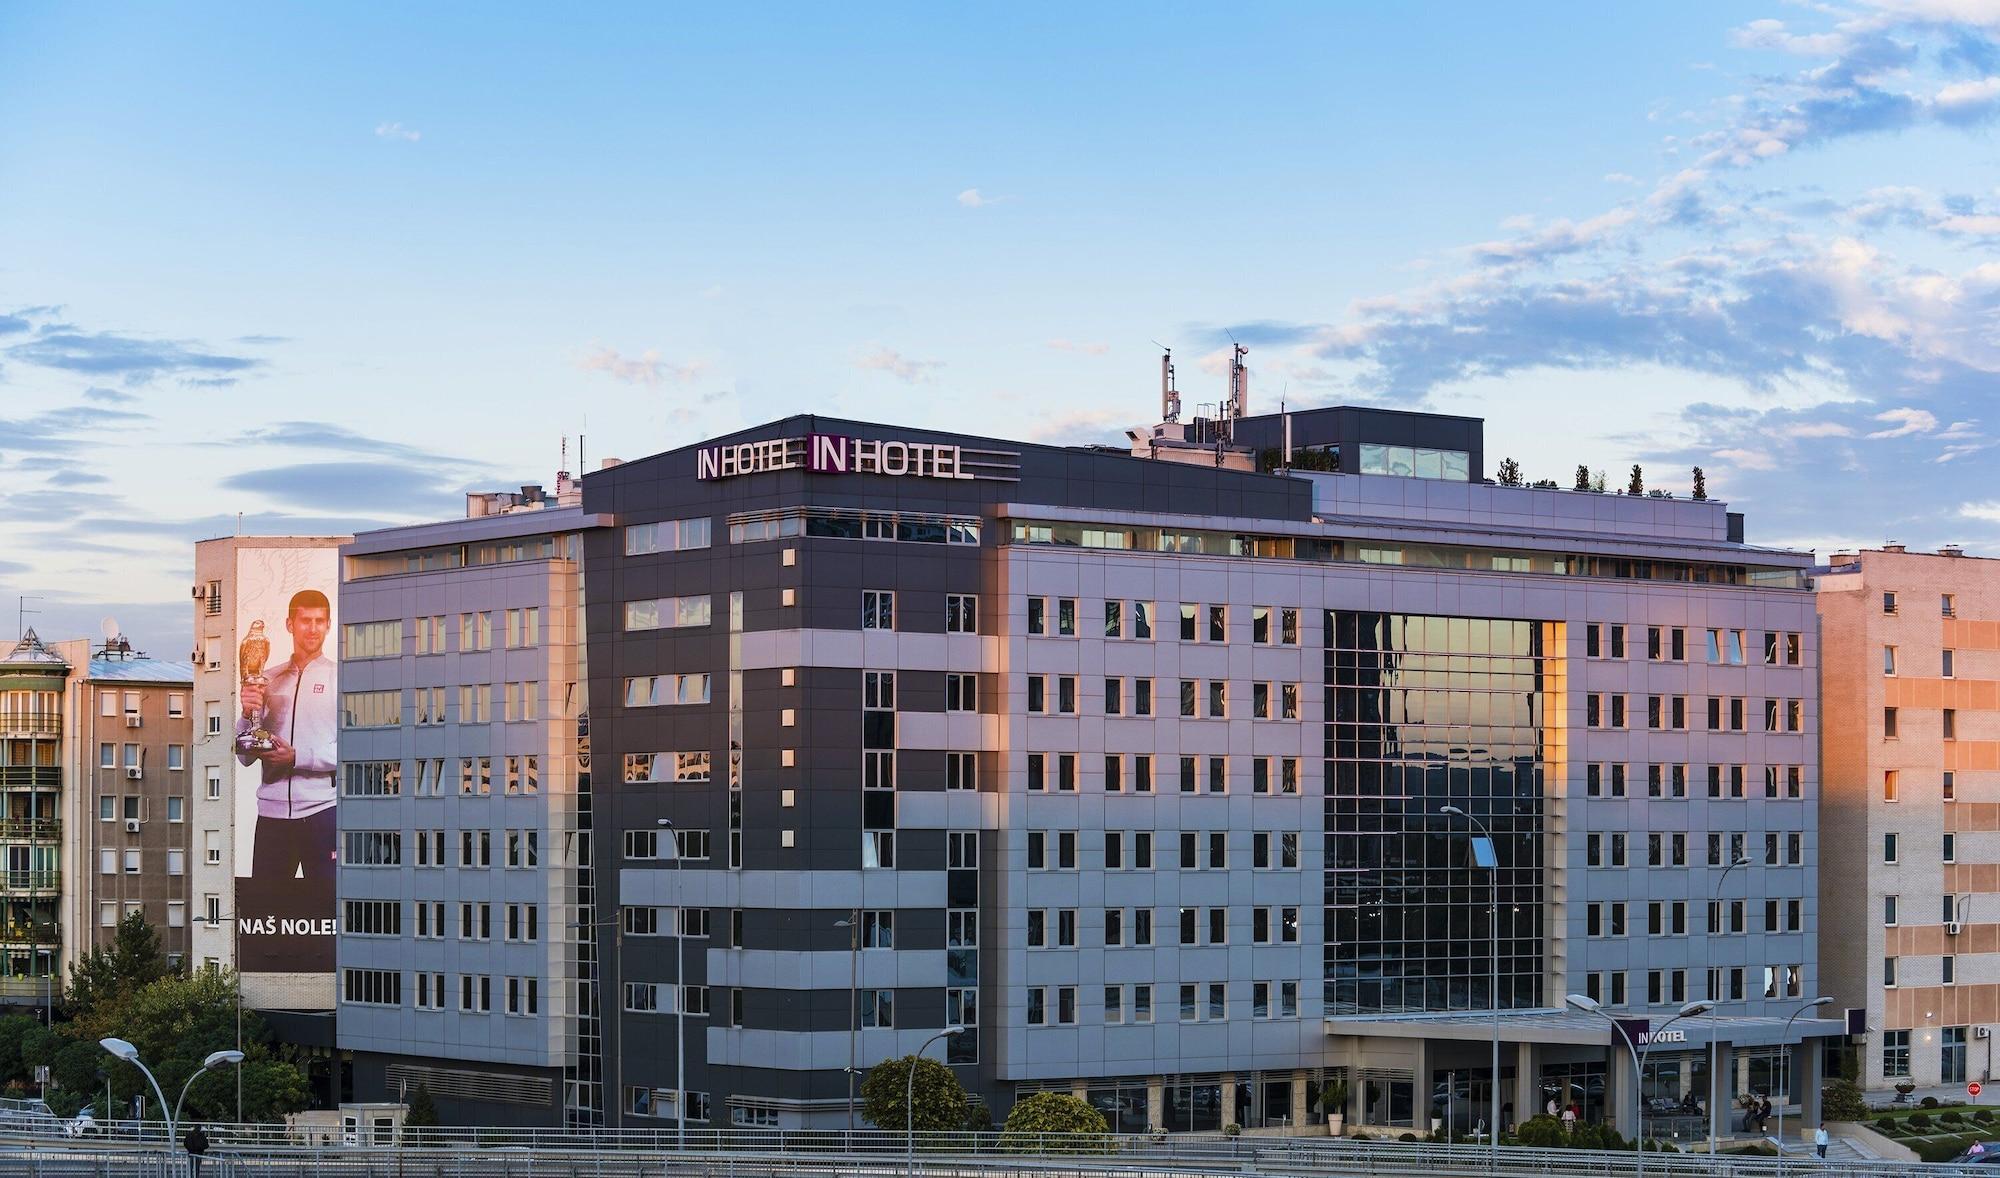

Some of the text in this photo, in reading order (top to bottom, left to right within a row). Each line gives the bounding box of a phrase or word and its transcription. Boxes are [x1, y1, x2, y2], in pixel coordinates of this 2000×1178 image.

[698, 438, 796, 480] IN HOTEL
[813, 435, 975, 480] IN HOTEL
[240, 915, 337, 935] NAŠ NOLE!
[1638, 1031, 1649, 1044] IN
